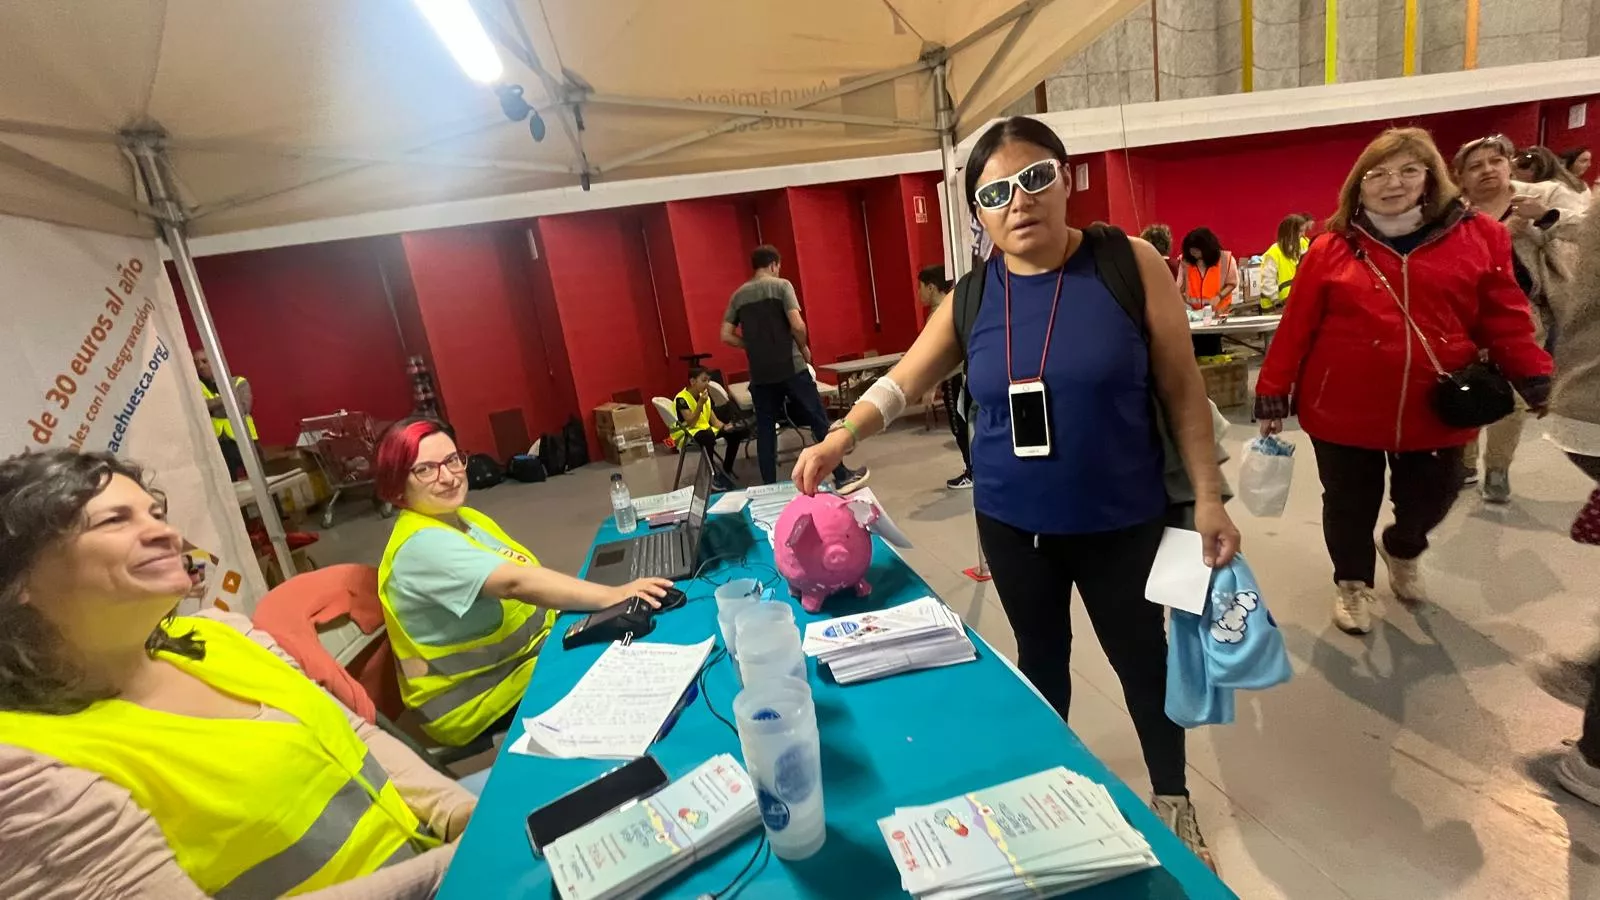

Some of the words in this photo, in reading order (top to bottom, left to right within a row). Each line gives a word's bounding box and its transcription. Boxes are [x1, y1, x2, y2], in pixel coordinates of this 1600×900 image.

[28, 411, 58, 445] de
[45, 374, 77, 410] 30
[71, 314, 114, 376] euros
[105, 287, 125, 317] al
[117, 257, 144, 295] año
[105, 297, 156, 381] desgravación)
[86, 395, 104, 422] con
[94, 381, 111, 397] la
[107, 336, 170, 454] acehuesca.org/
[68, 423, 91, 453] les
